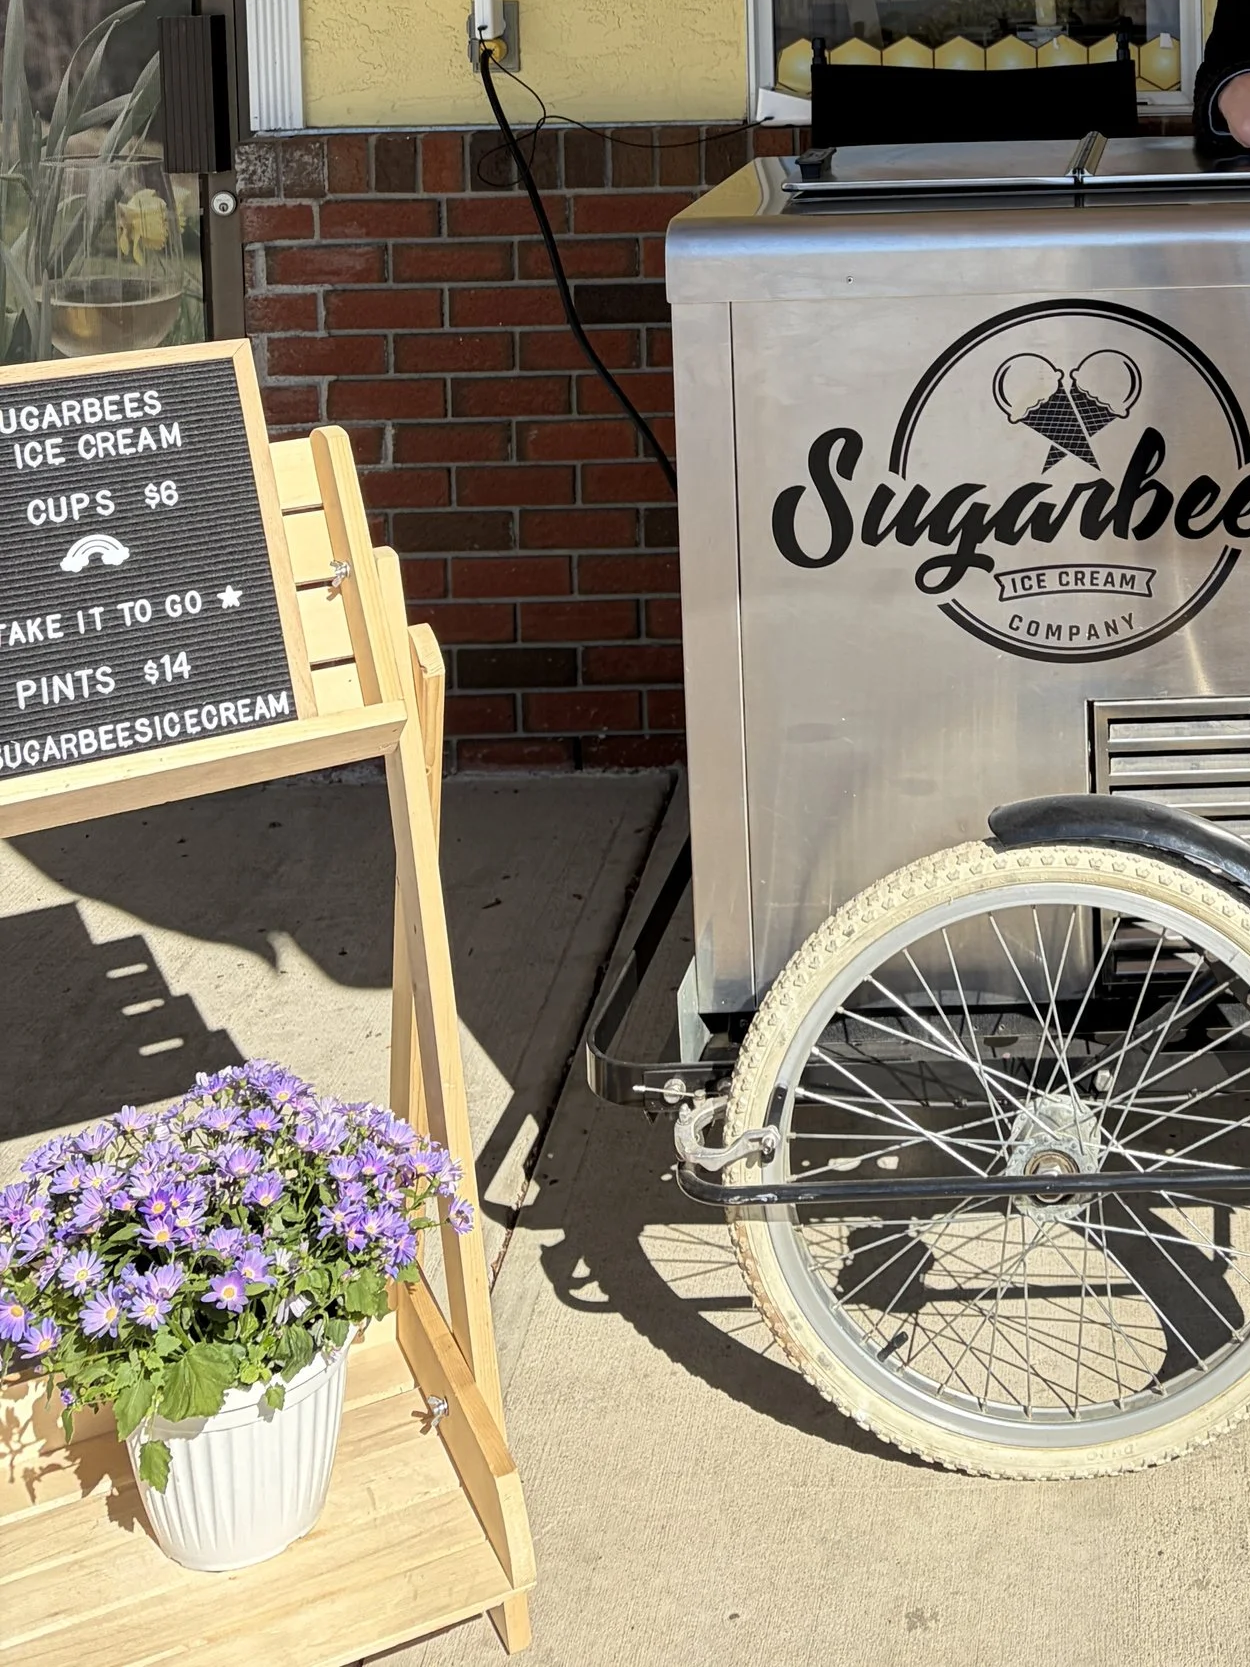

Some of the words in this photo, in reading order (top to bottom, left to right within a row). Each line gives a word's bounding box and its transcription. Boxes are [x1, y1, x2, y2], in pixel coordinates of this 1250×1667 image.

[14, 437, 66, 470] ICE
[77, 422, 183, 461] CREAM
[26, 489, 116, 526] CUPS
[144, 479, 179, 510] $6
[1011, 572, 1047, 594] ICE
[1058, 570, 1137, 590] CREAM
[77, 606, 104, 634] IT
[117, 599, 152, 627] TO
[165, 590, 203, 618] GO
[1008, 612, 1134, 642] COMPANY
[15, 665, 116, 710] PINTS
[143, 651, 192, 685] $14
